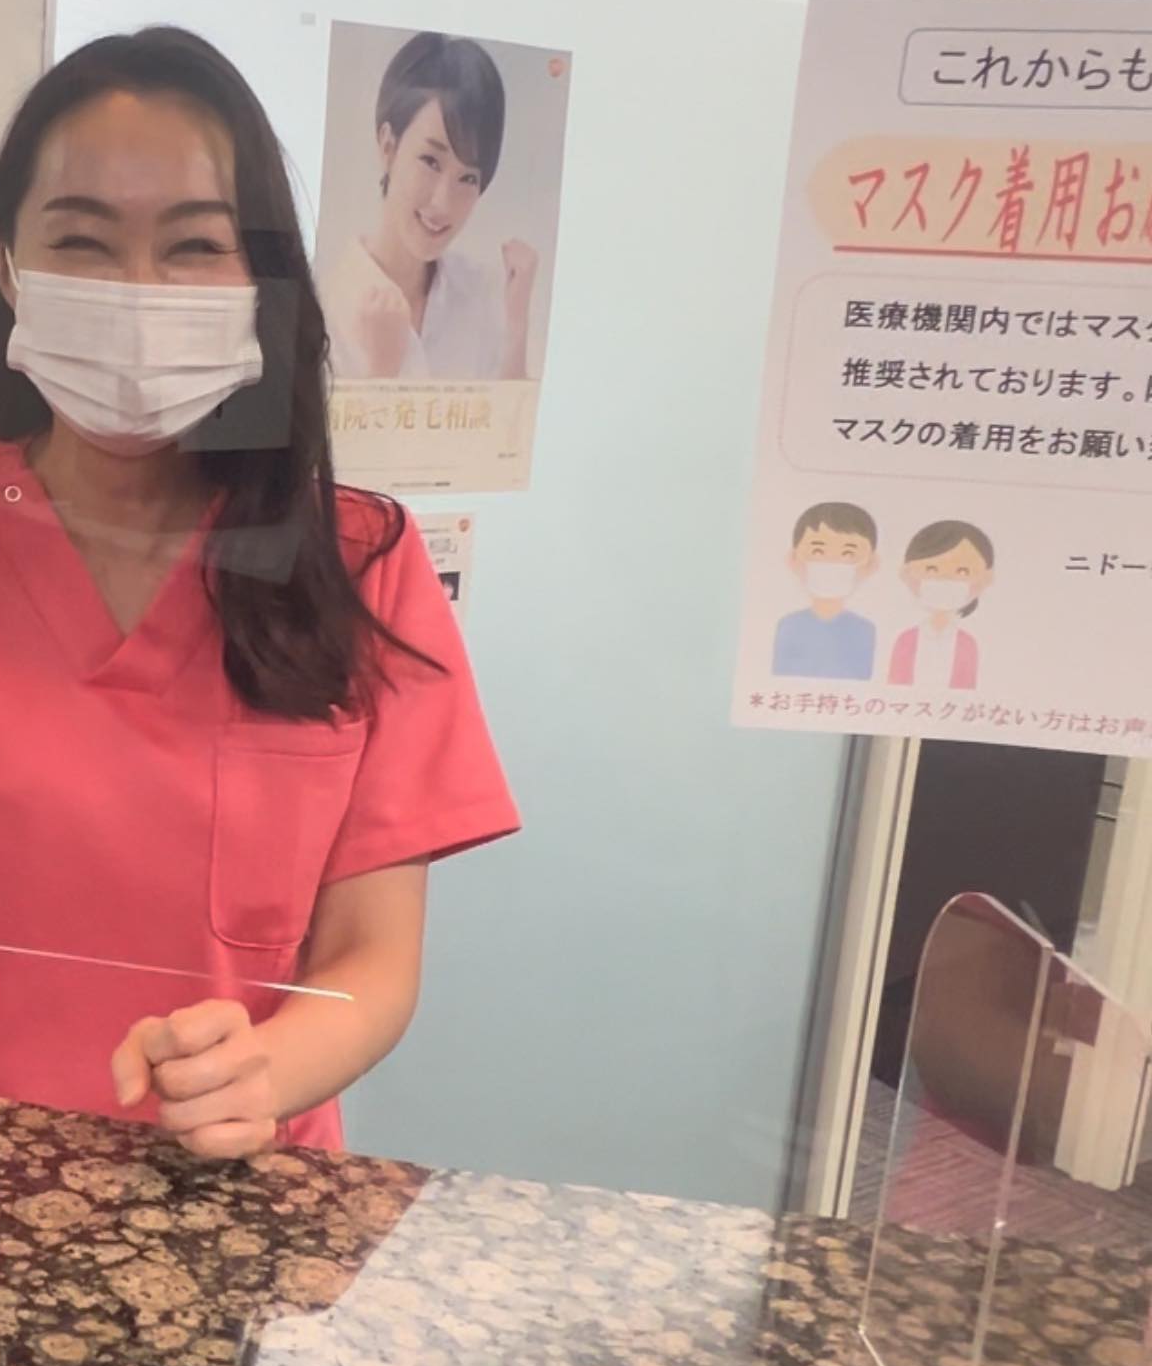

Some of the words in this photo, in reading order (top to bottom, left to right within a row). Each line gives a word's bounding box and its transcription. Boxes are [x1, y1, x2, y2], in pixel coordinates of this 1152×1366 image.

[932, 45, 1152, 92] これからも
[848, 144, 1152, 253] マスク着用お
[844, 299, 1152, 343] 医療機関内ではマス
[841, 356, 1152, 403] 推奨されております。
[832, 417, 1152, 460] マスクの着用をお願い
